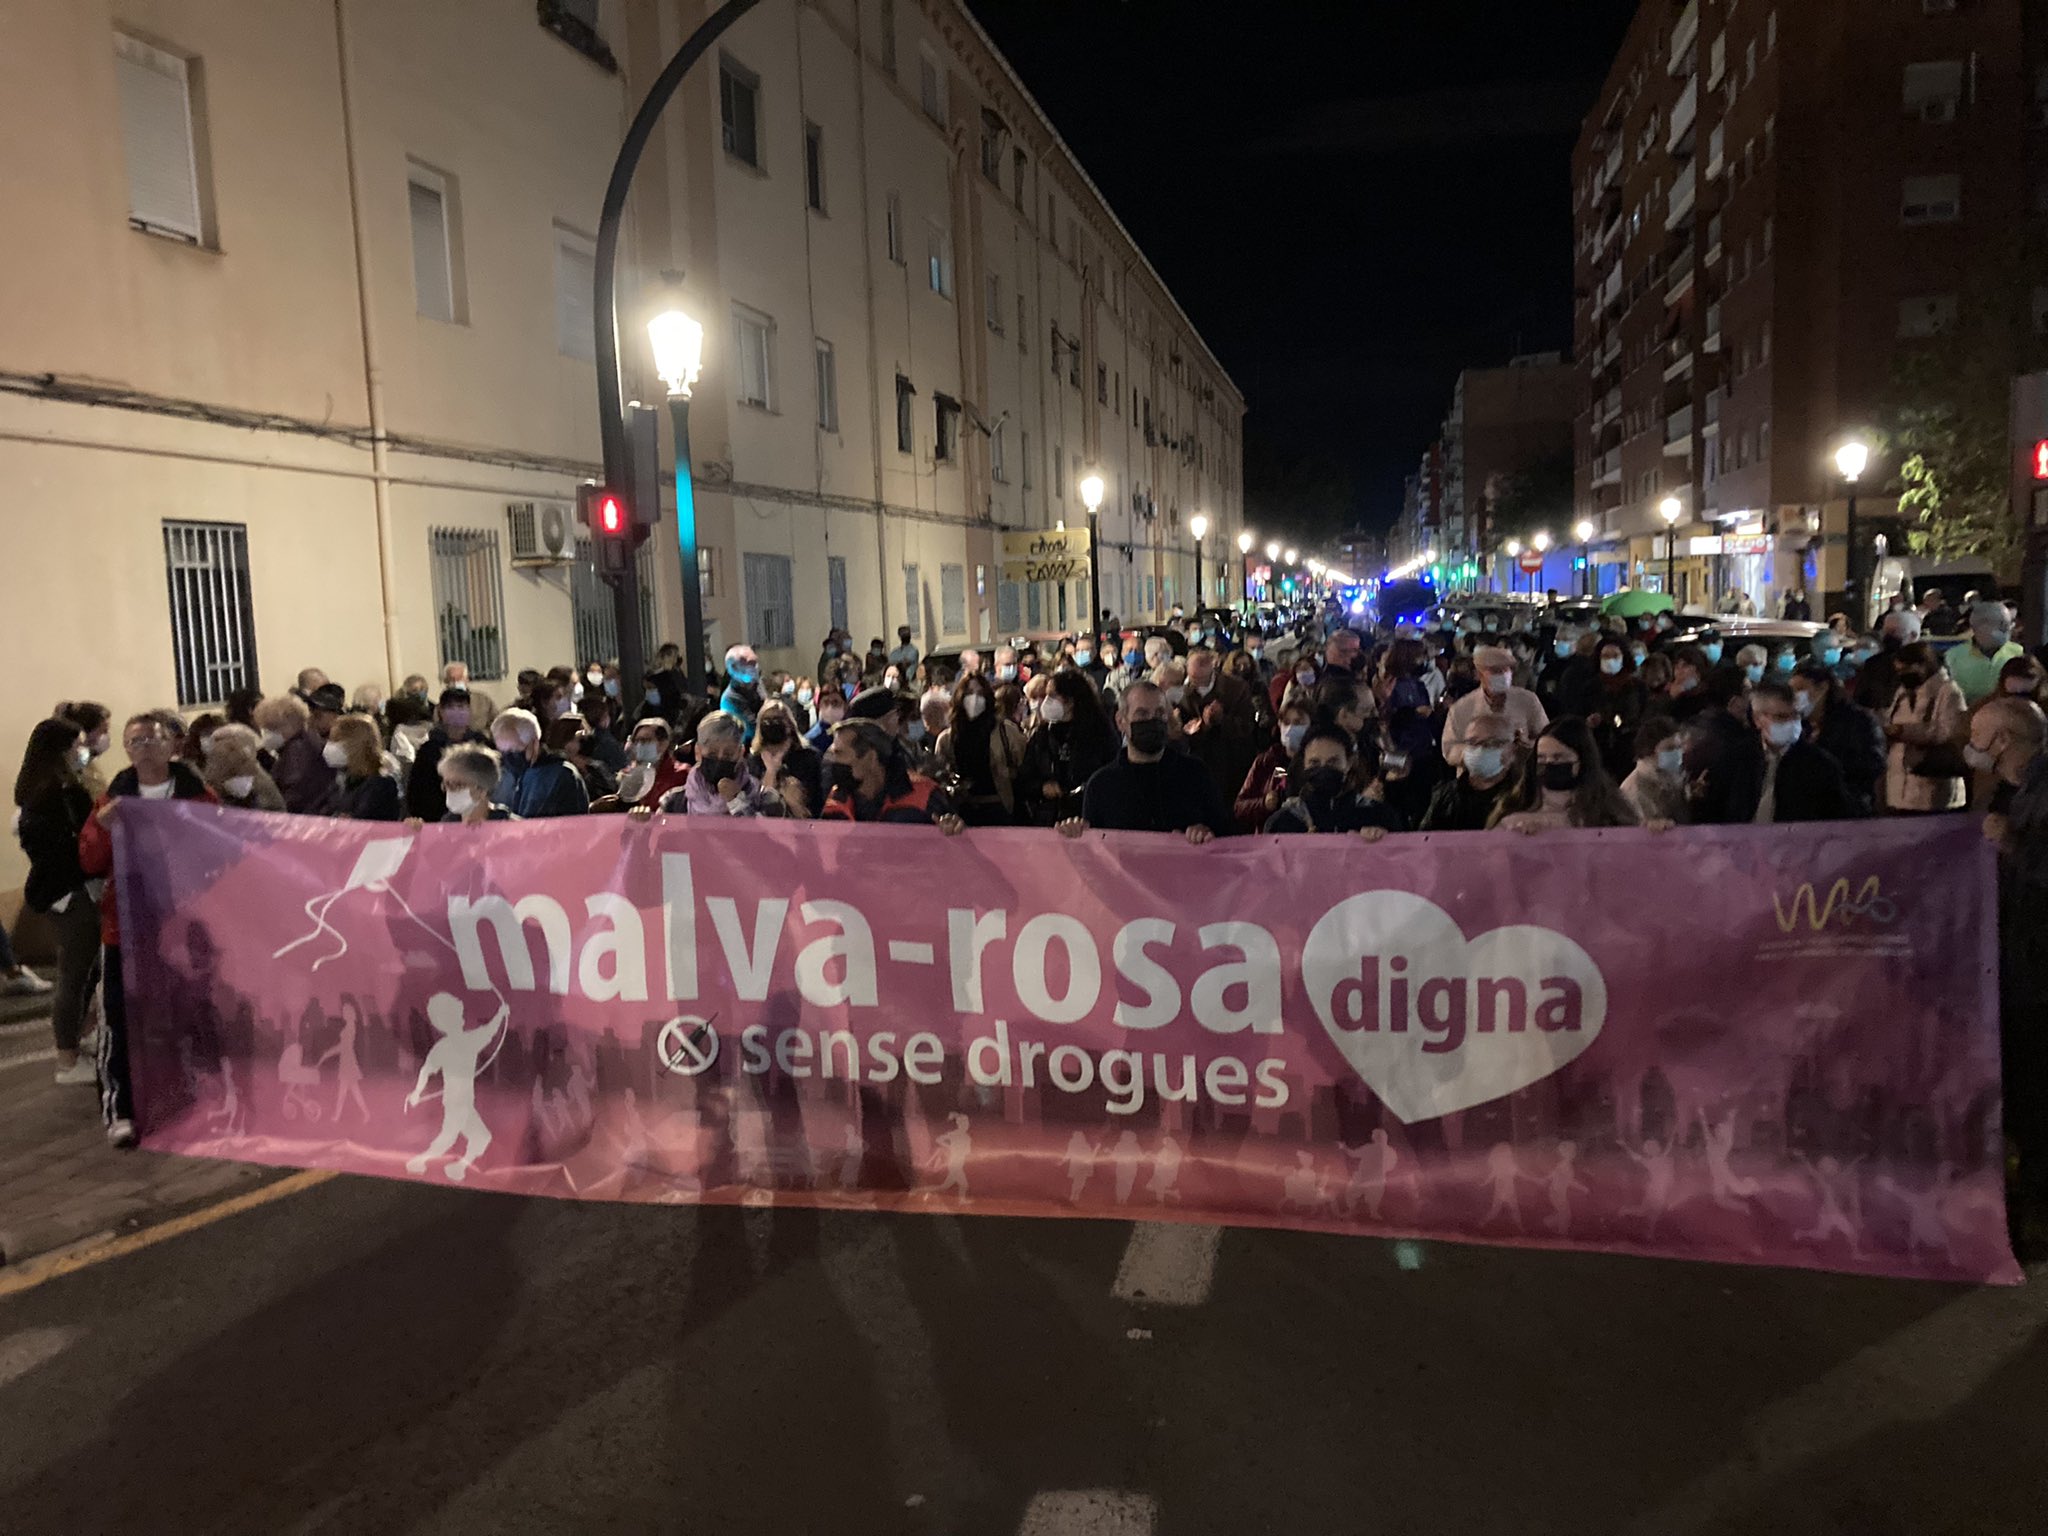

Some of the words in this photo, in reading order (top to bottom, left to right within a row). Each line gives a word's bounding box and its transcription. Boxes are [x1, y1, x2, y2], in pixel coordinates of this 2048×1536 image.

[447, 852, 1285, 1035] malva-rosa
[1329, 954, 1583, 1053] digna
[741, 1024, 945, 1085] sense
[967, 1020, 1290, 1115] drogues
